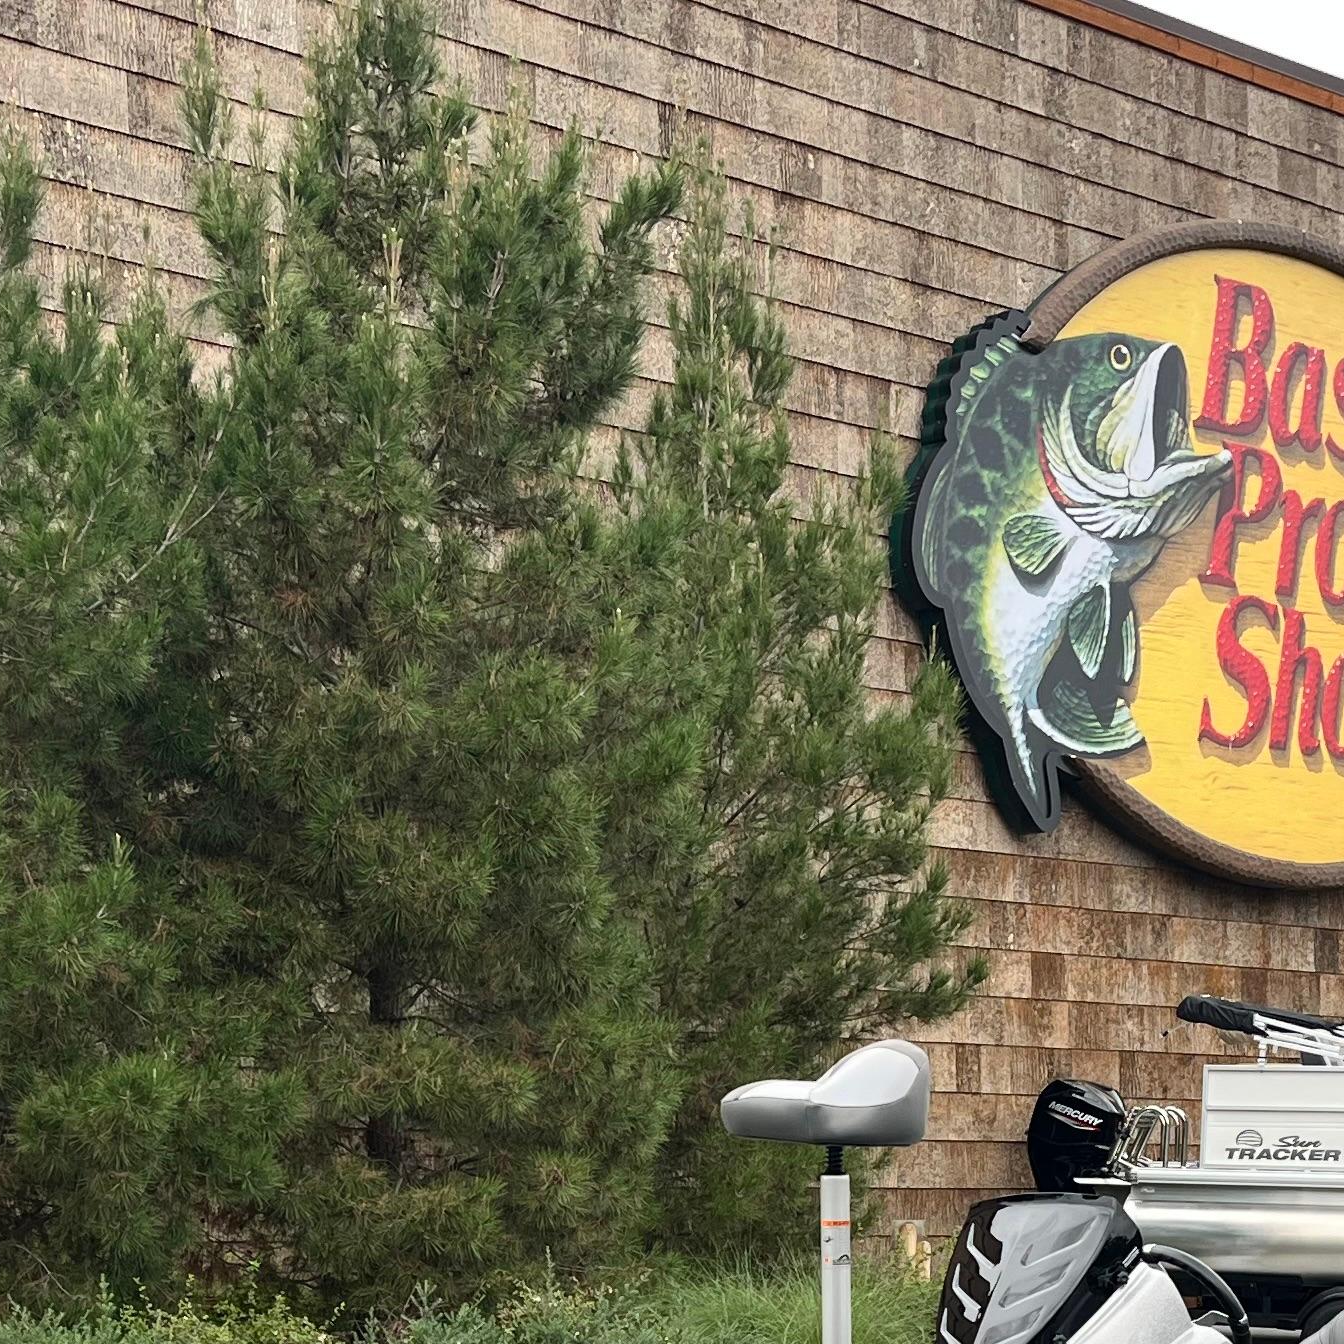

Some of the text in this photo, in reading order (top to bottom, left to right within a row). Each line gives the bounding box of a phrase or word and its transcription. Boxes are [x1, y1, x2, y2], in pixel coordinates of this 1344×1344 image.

[1048, 1101, 1104, 1127] MERCURY
[1272, 1135, 1322, 1148] Sun
[1225, 1148, 1342, 1162] TRACKER
